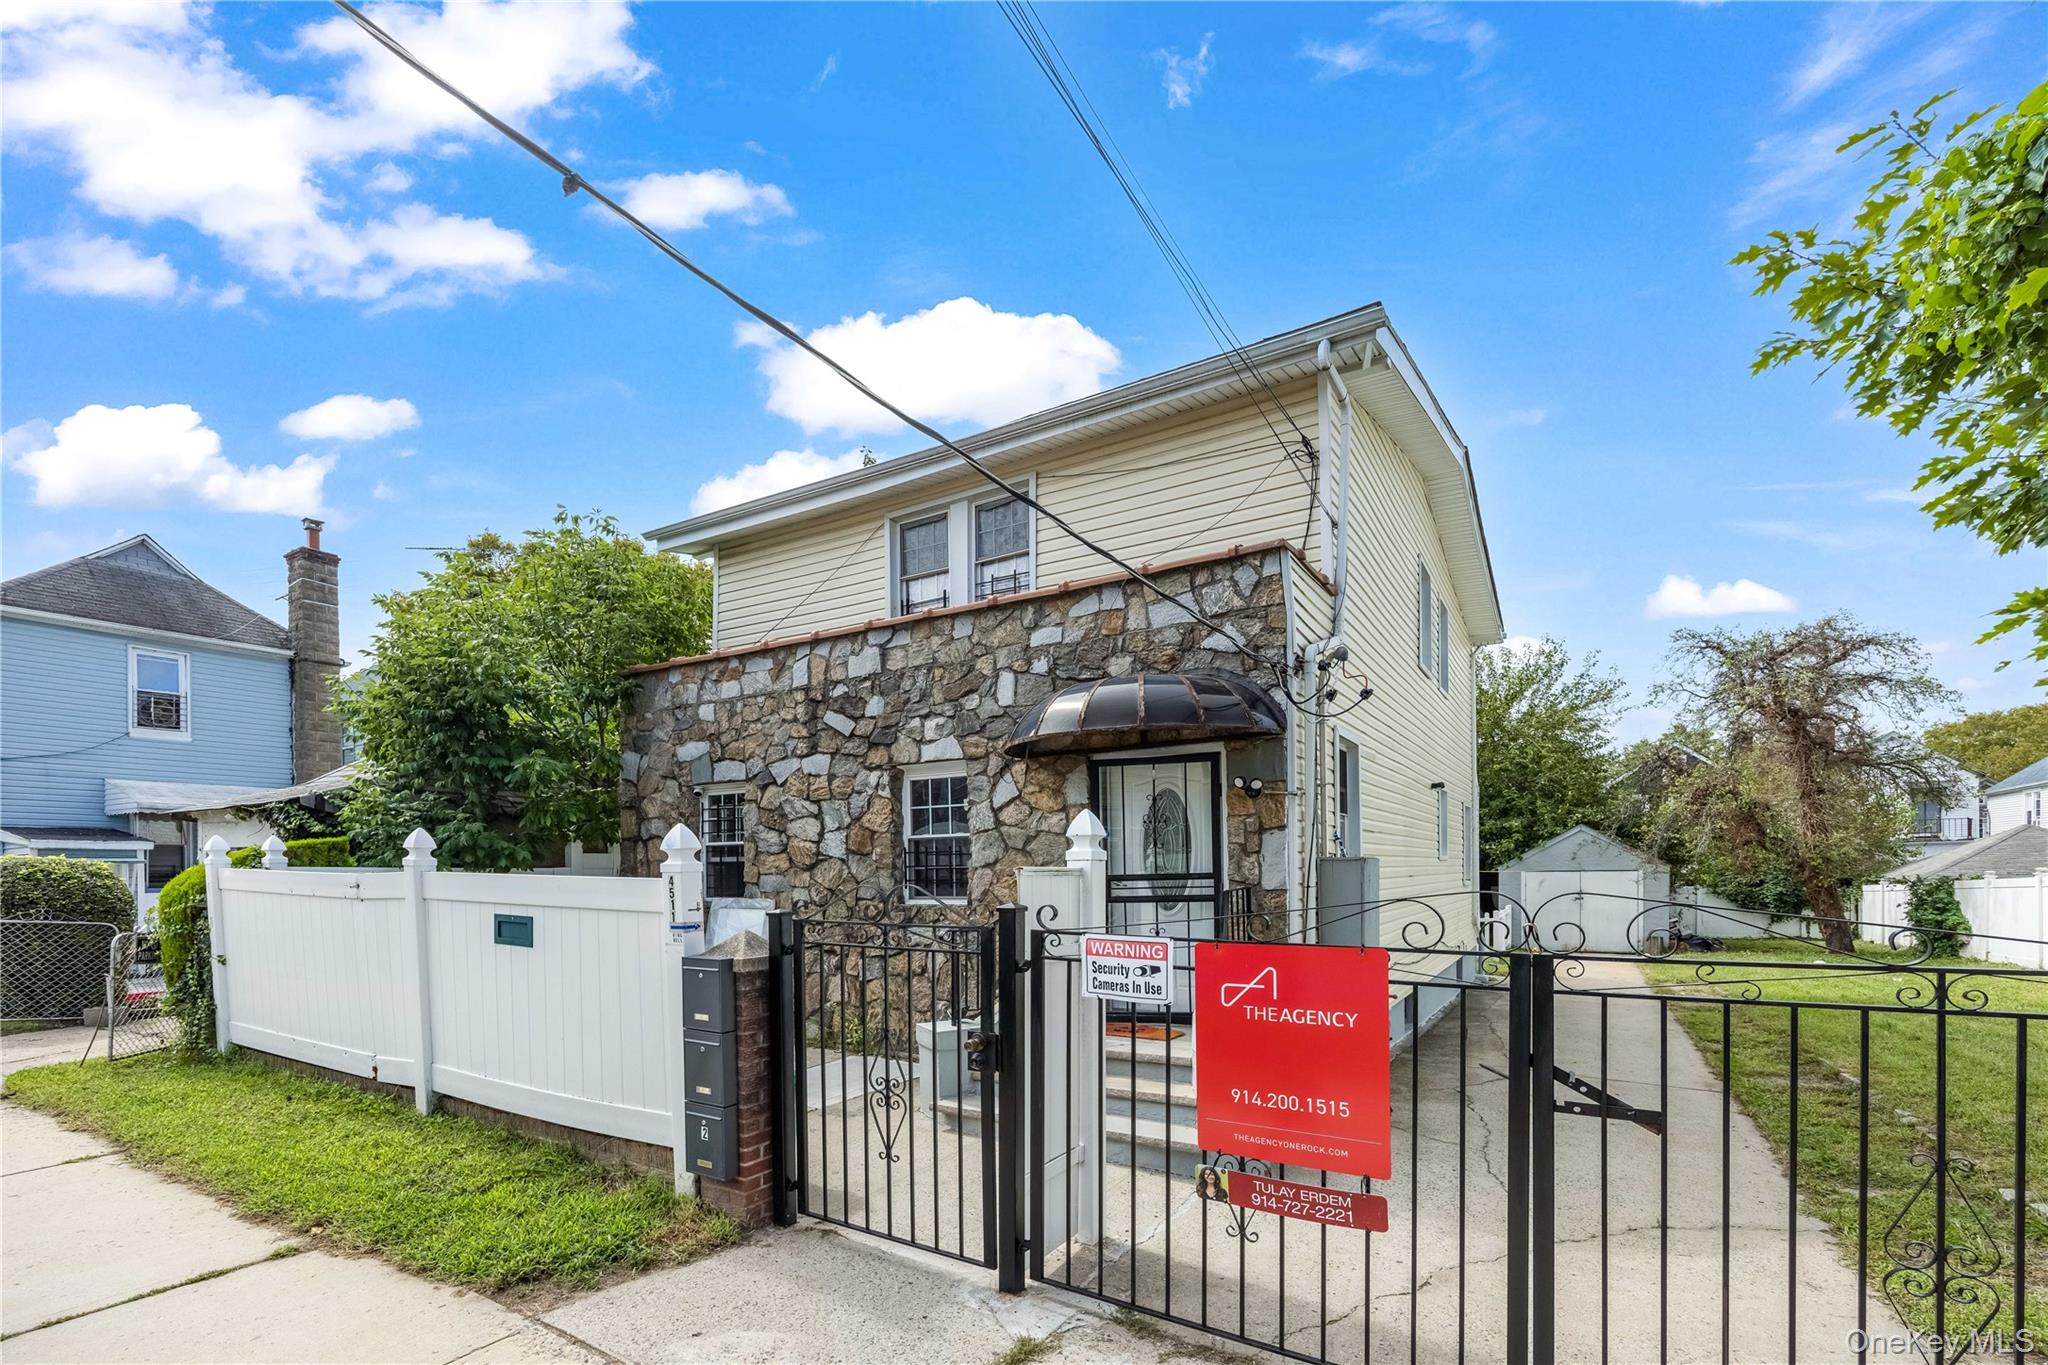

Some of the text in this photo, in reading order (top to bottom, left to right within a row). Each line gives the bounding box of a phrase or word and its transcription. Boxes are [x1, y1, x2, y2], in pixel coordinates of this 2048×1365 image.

[1091, 941, 1164, 959] WARNING
[1091, 961, 1130, 979] Security
[1092, 977, 1162, 995] Cameras In Use
[1231, 1088, 1350, 1118] 914.200.1515
[702, 1128, 708, 1139] 2
[1234, 1133, 1349, 1158] THEAGENCYONEROCK.COM
[1253, 1181, 1352, 1208] TULAY ERDEM
[1251, 1193, 1354, 1223] 914-727-2221
